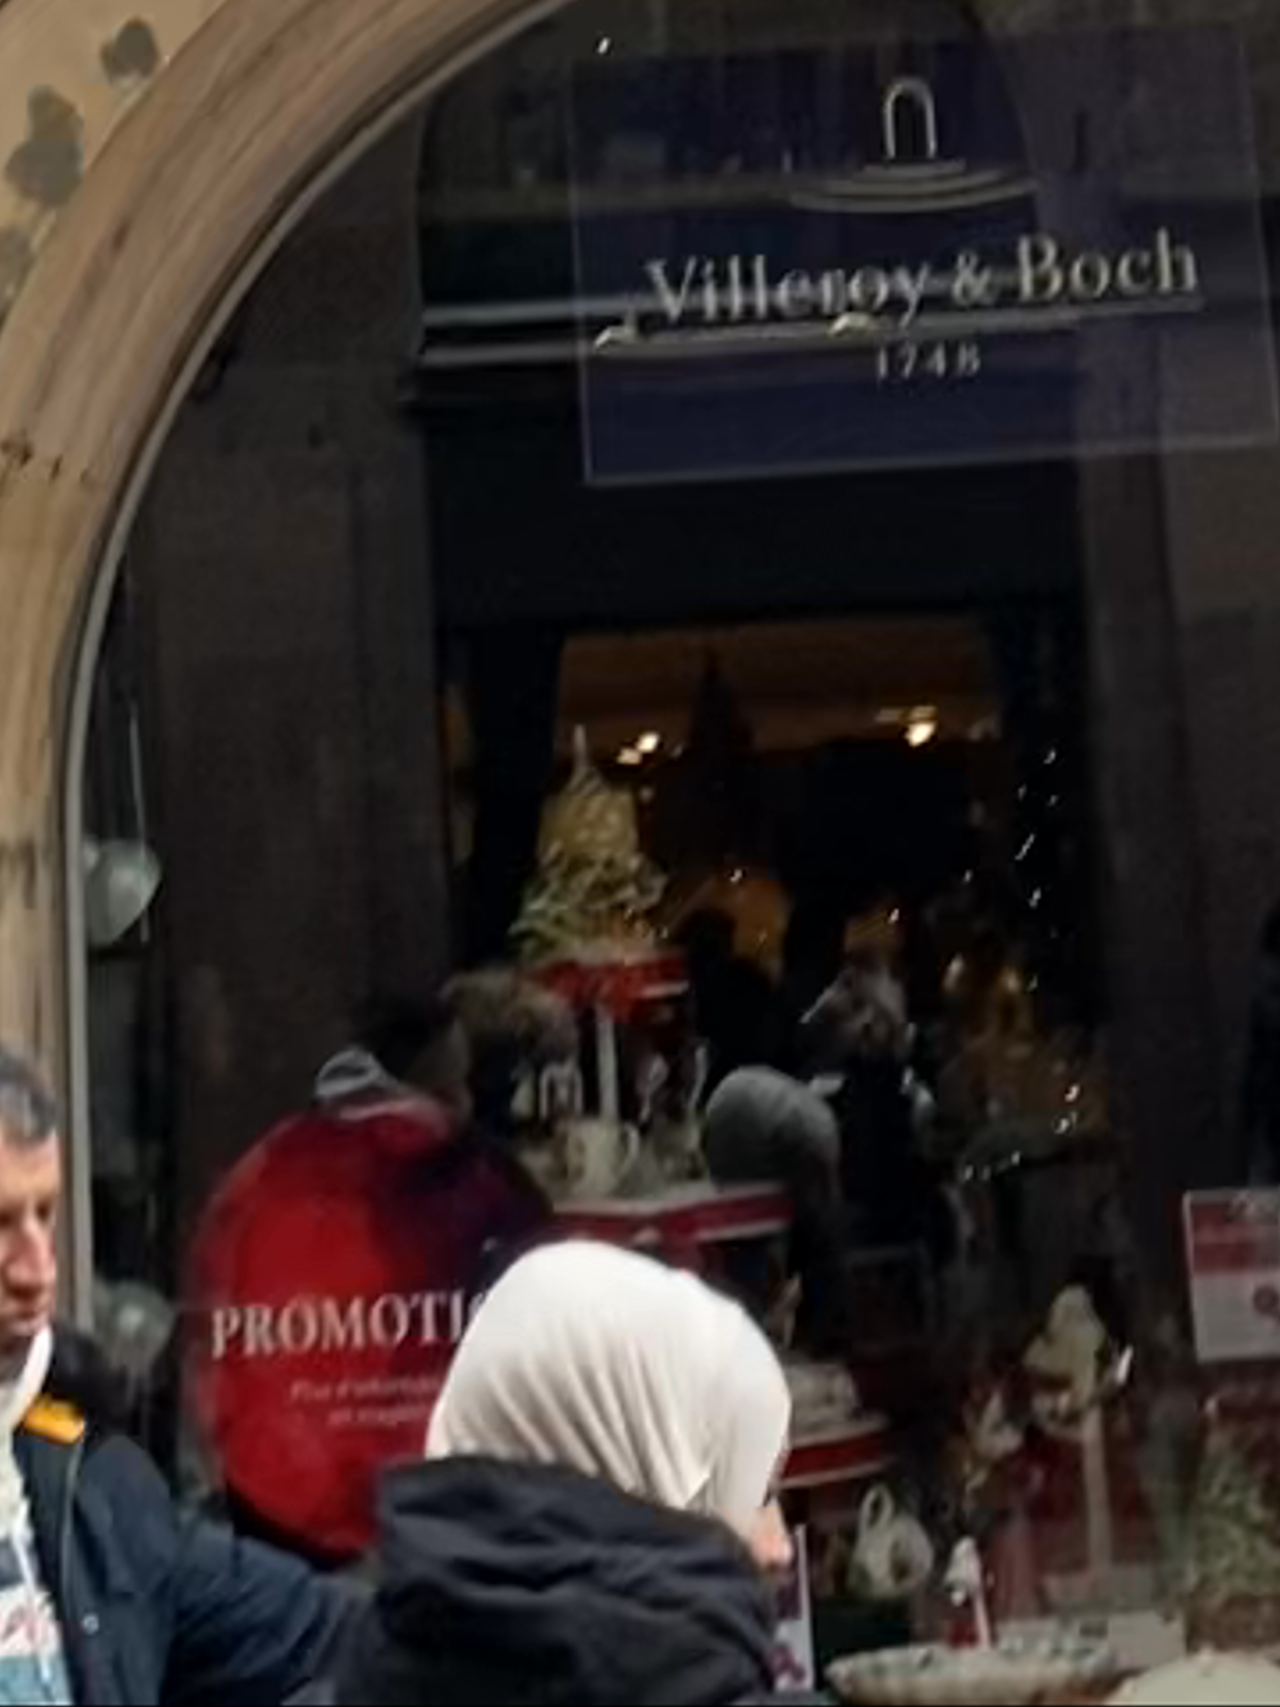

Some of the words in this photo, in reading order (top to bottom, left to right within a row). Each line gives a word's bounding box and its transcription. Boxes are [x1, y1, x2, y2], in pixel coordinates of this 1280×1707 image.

[645, 253, 932, 328] Villeroy
[951, 250, 996, 306] &
[1017, 226, 1200, 303] Boch
